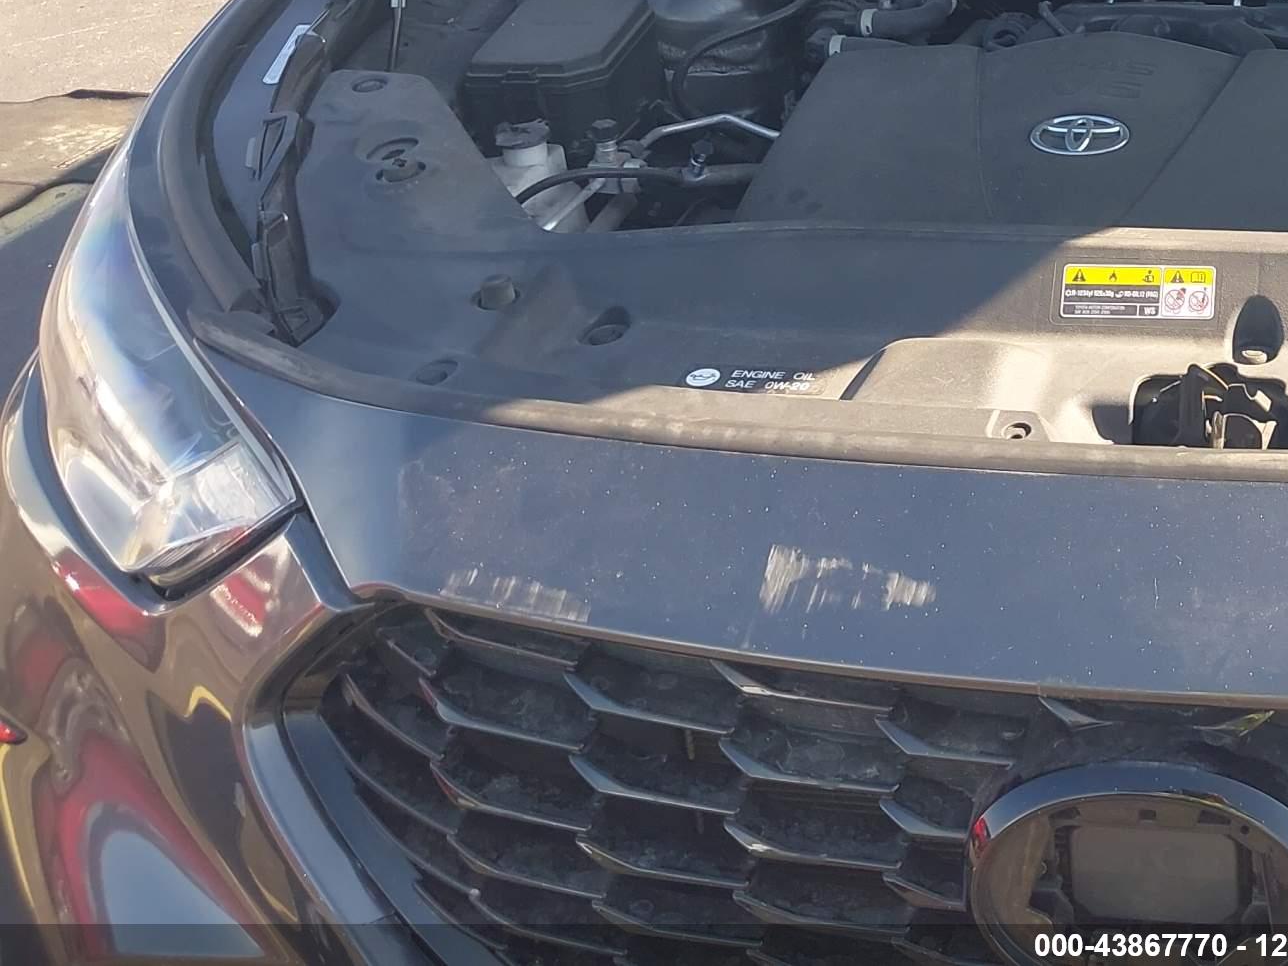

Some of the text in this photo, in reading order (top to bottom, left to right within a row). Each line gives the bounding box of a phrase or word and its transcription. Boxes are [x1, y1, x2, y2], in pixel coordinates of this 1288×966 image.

[731, 369, 816, 381] ENGINE OIL
[725, 379, 811, 391] SAE 0W-20
